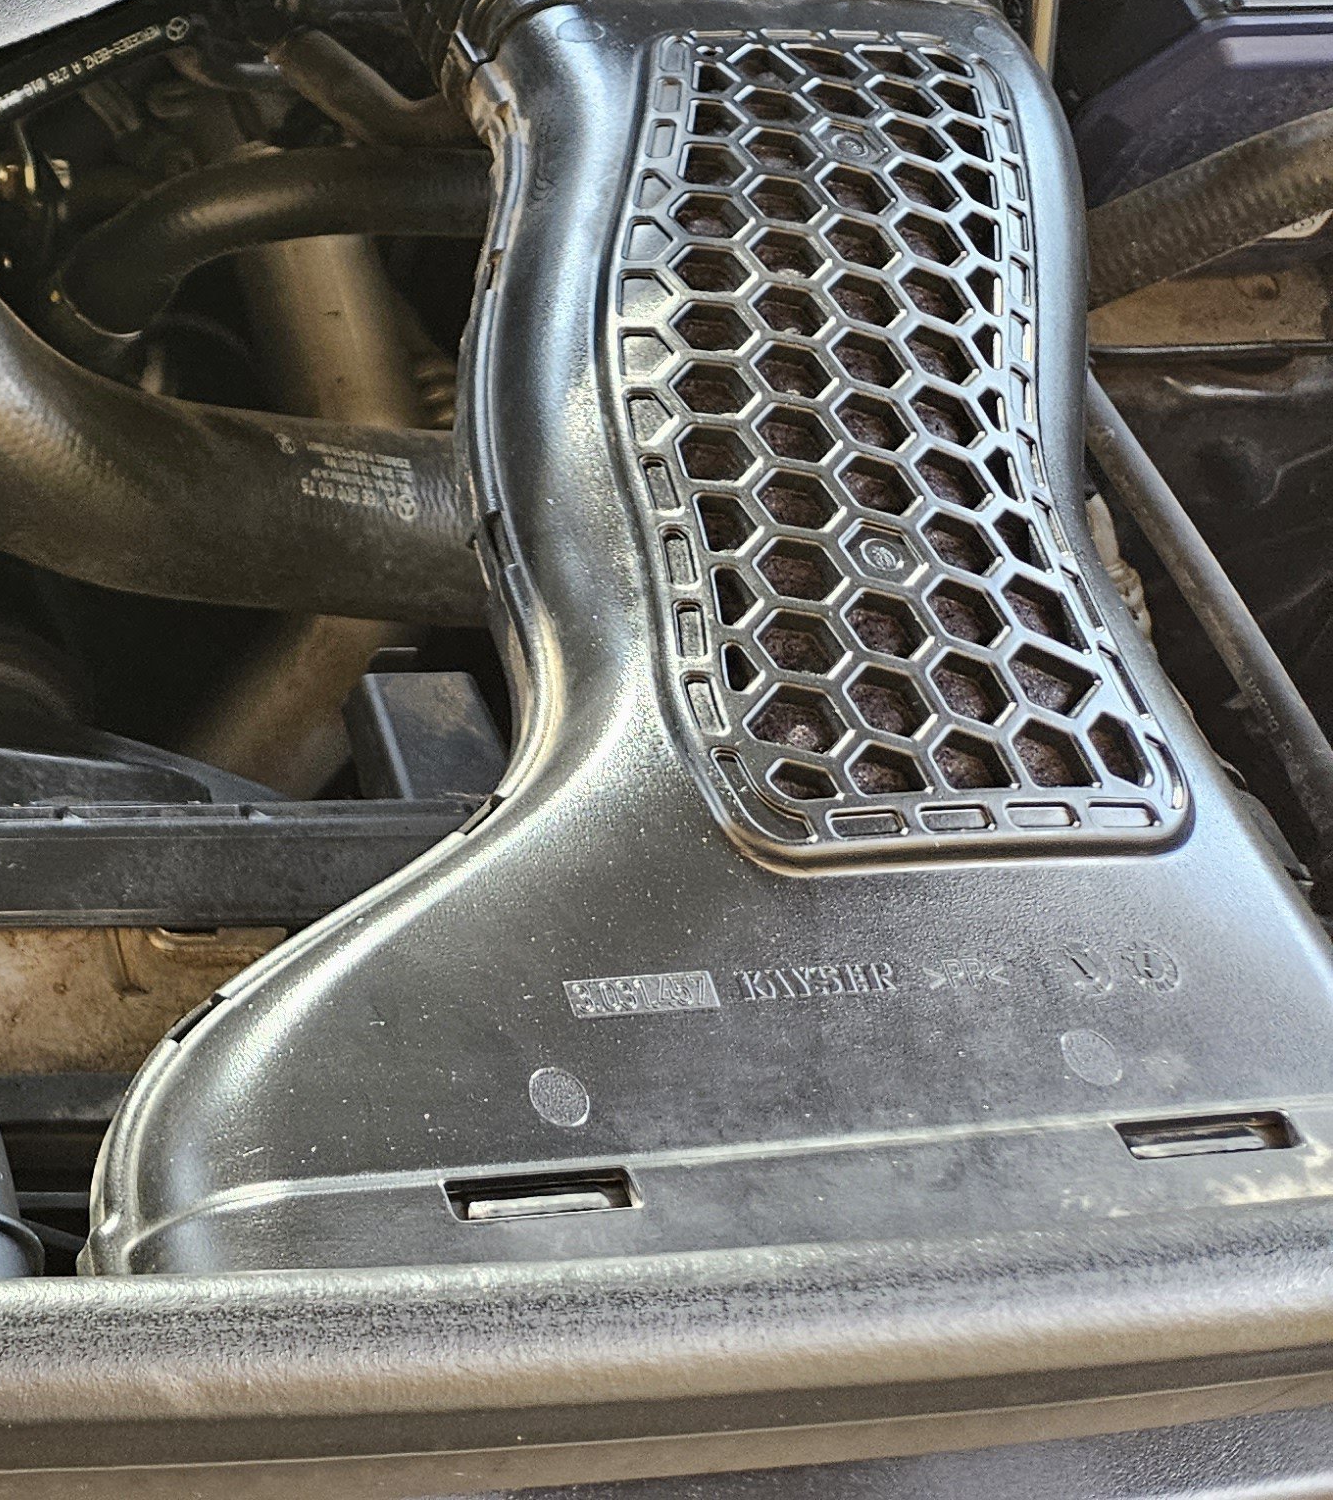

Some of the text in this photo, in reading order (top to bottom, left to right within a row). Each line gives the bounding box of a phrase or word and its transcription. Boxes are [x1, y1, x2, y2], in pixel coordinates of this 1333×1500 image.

[45, 66, 70, 87] 276
[71, 60, 84, 75] A
[571, 974, 711, 1015] 3.031.457
